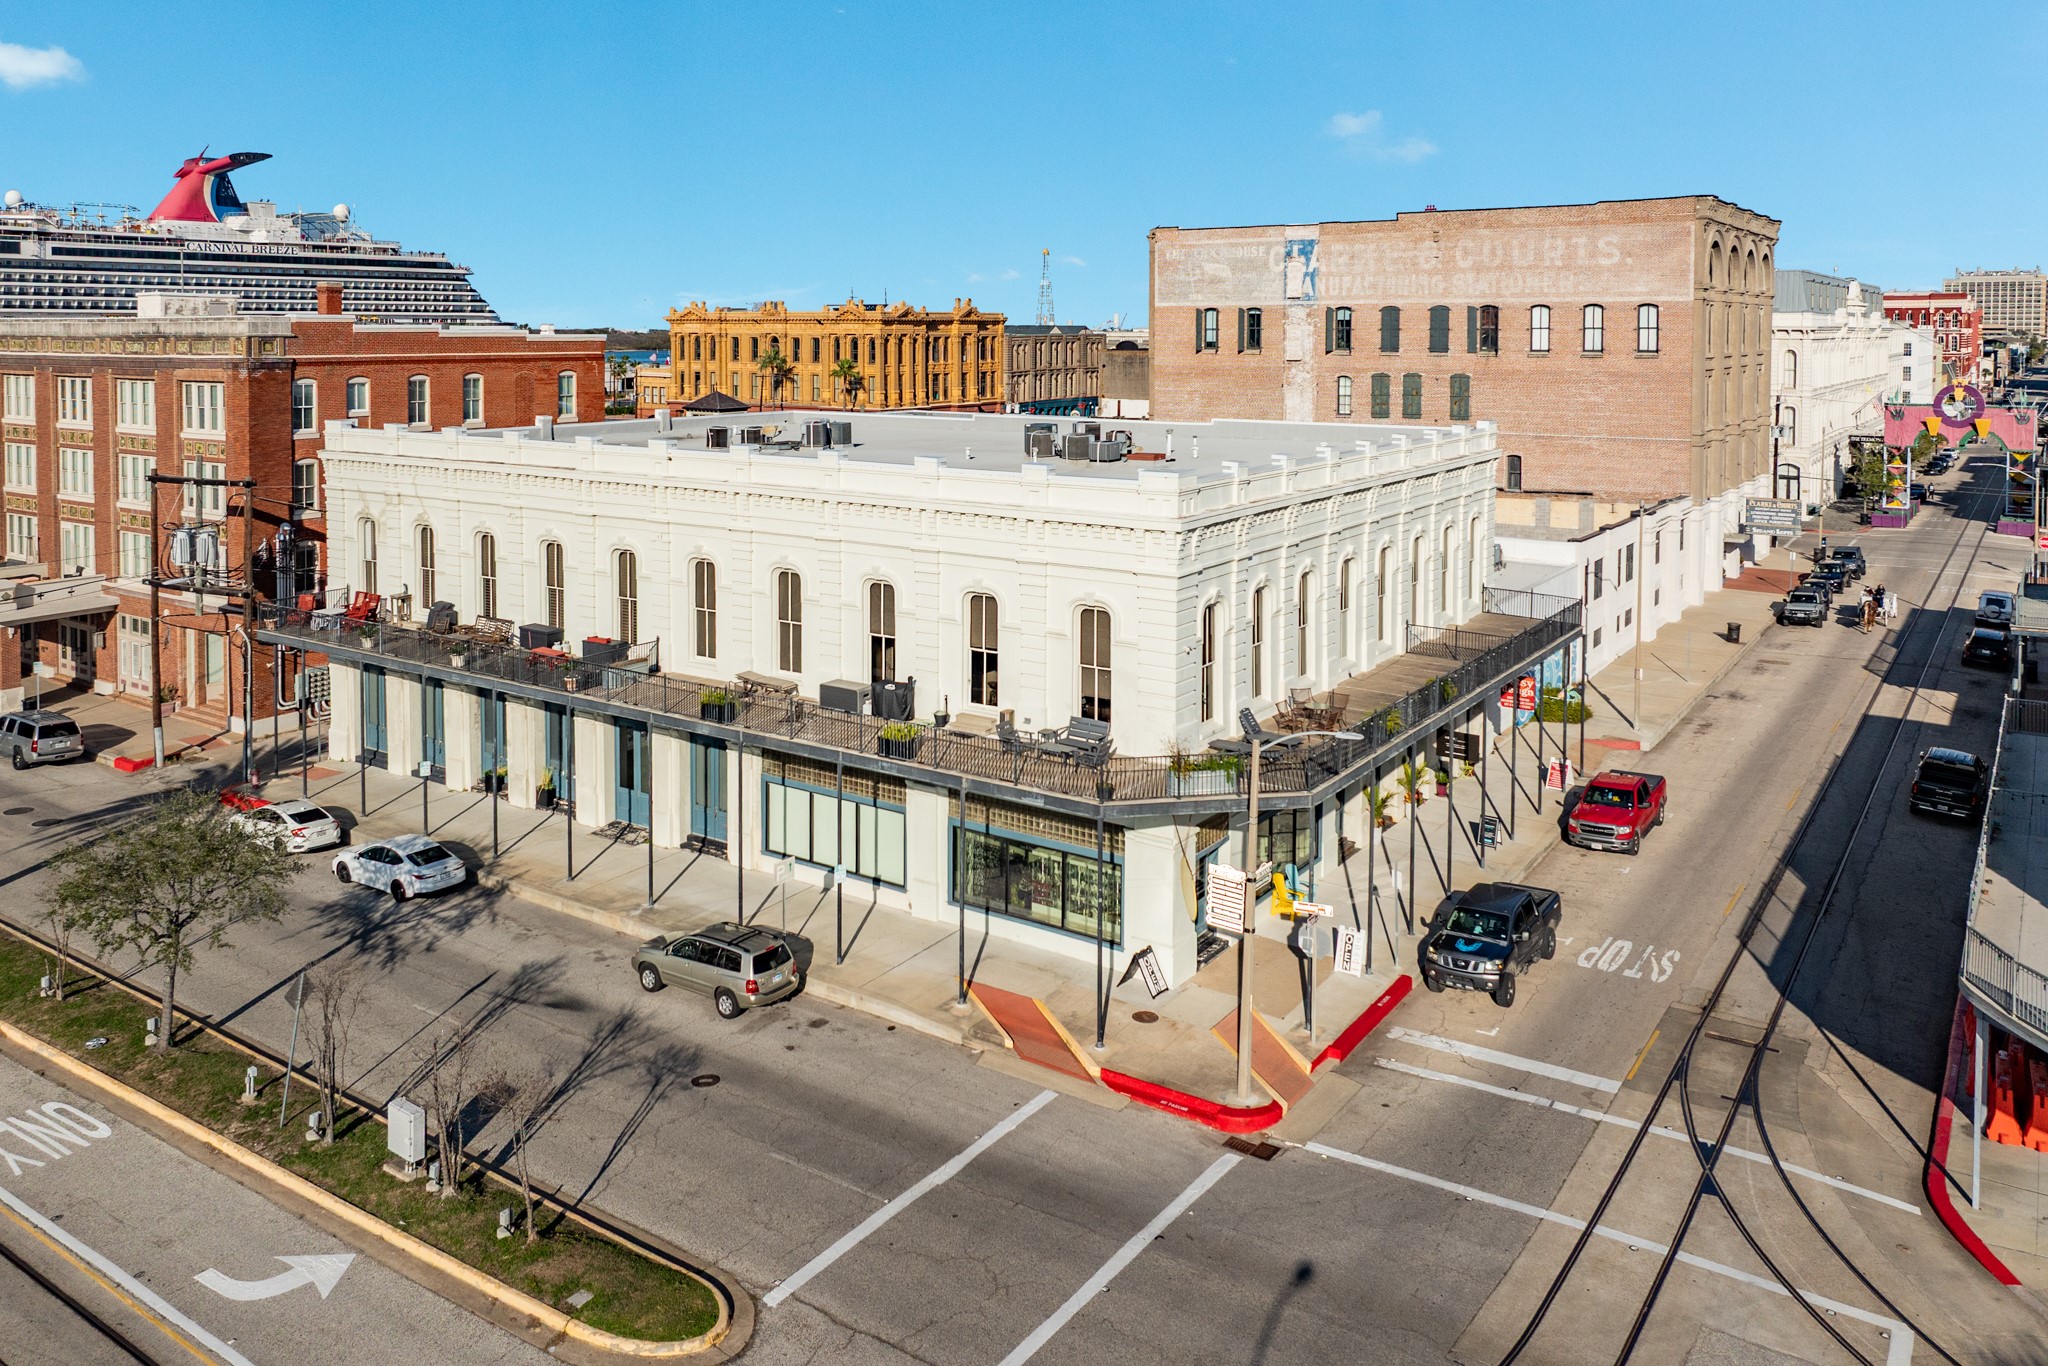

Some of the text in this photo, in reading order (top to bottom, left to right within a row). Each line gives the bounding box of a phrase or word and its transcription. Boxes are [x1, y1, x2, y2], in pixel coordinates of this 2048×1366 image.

[186, 242, 299, 255] CARNIVAL BREEZE
[1343, 934, 1354, 972] OPEN
[1578, 936, 1681, 983] STOP
[1144, 956, 1161, 993] OPEN
